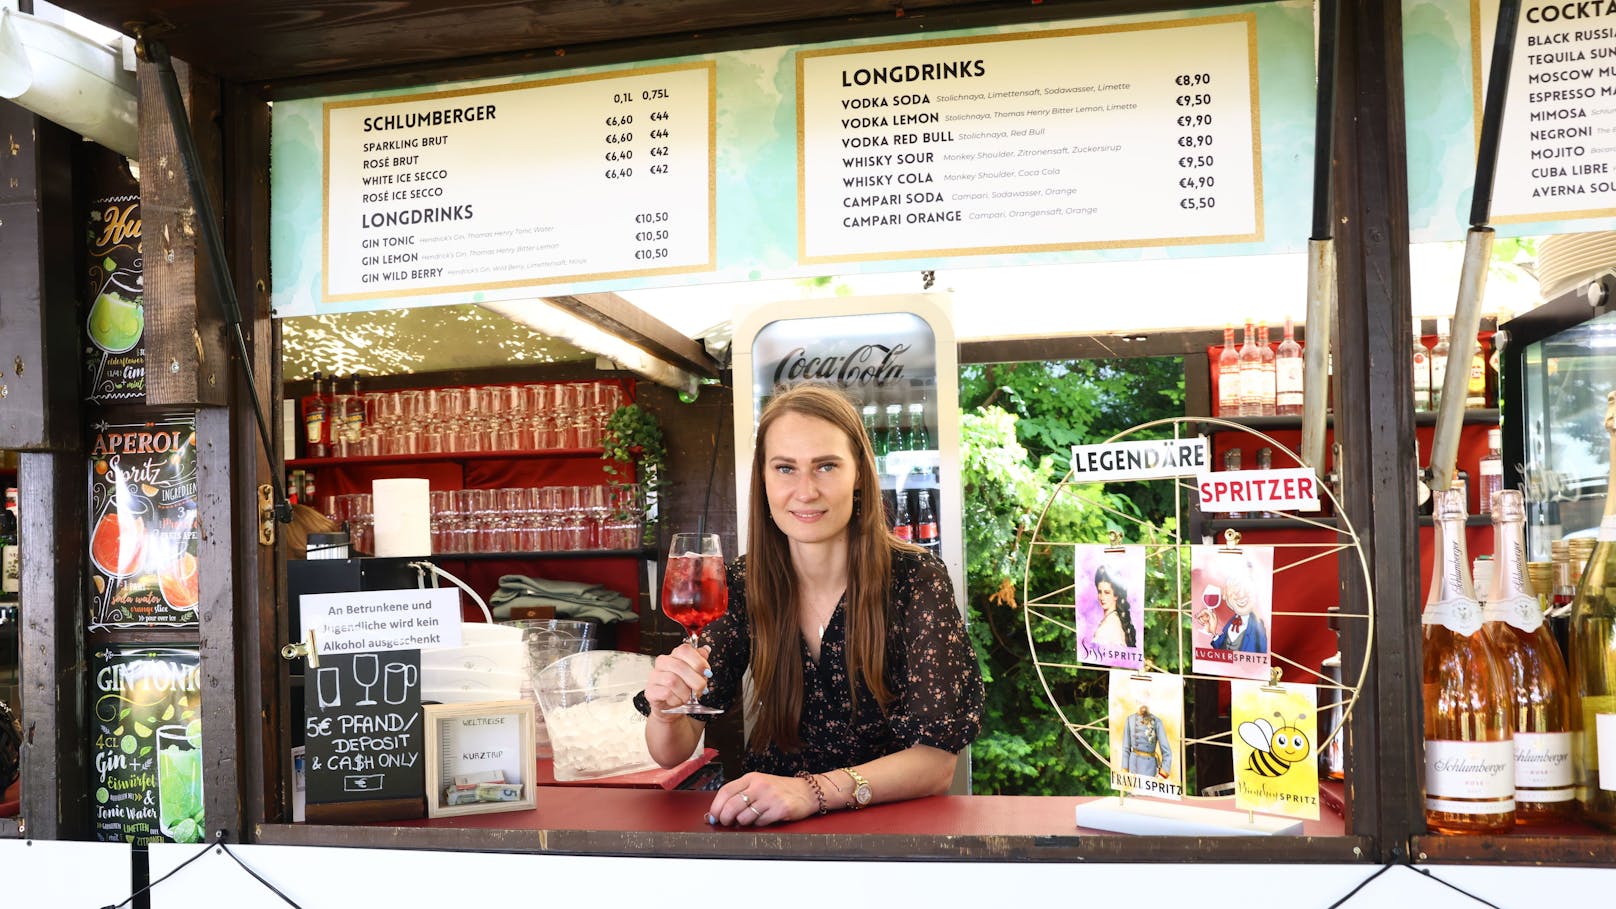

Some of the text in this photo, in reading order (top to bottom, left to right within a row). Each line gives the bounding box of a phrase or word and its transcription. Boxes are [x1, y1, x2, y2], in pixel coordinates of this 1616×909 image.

[1528, 28, 1616, 47] BLACK RUSSI
[1528, 51, 1585, 66] TEQUILA
[842, 60, 985, 87] LONGDRINKS
[1528, 68, 1594, 84] MOSCOW
[614, 88, 669, 104] 0,1L 0,75L
[842, 73, 1210, 110] VODKA SODA Stolichnaya, Limettensaft, Sodawasser, Limette €8,90
[1529, 87, 1596, 103] ESPRESSO
[363, 104, 497, 132] SCHLUMBERGER
[842, 93, 1211, 129] VODKA LEMON Stolichnaya, Thomas Henry Bitter Lemon, Limette €9,50
[1530, 108, 1586, 122] MIMOSA
[363, 111, 669, 152] SPARKLING BRUT €6,60 €44
[842, 114, 1212, 148] VODKA RED BULL Stolichnaya, Red Bull €9,90
[1530, 126, 1592, 141] NEGRONI
[363, 129, 669, 169] ROSÉ BRUT €6,60 €44
[842, 135, 1213, 168] WHISKY SOUR Monkey Shoulder, Zitronensaft, Zuckersirup €8,90
[1531, 146, 1585, 160] MOJITO
[362, 146, 669, 186] WHITE ICE SECCO €6,40 €42
[843, 155, 1214, 188] WHISKY COLA Monkey Shoulder, Coca Cola €9,50
[1531, 163, 1609, 179] CUBA LIBRE
[362, 164, 669, 203] ROSÉ ICE SECCO €6,40 €42
[843, 194, 901, 208] CAMPARI
[906, 192, 944, 204] SODA
[991, 189, 1043, 199] Sodawasser,
[1044, 186, 1078, 196] Orange
[1179, 176, 1215, 190] €4,90
[1532, 184, 1586, 198] AVERNA
[362, 204, 473, 229] LONGDRINKS
[843, 214, 901, 228] CAMPARI
[906, 210, 962, 224] ORANGE
[1009, 206, 1064, 218] Orangensaft,
[1065, 205, 1098, 215] Orange
[1180, 197, 1215, 210] €5,50
[362, 212, 669, 249] GIN TONIC €10,50
[362, 230, 669, 266] GIN LEMON €10,50
[362, 274, 379, 284] GIN
[382, 270, 408, 282] WILD
[411, 267, 444, 280] BERRY
[635, 248, 668, 260] €10,50
[773, 343, 912, 388] Coca-Cola
[92, 431, 183, 455] APEROL
[1075, 441, 1205, 473] LEGENDÄRE
[105, 455, 171, 486] Spritz
[1201, 477, 1313, 503] SPRITZER
[328, 600, 432, 616] An Betrunkene und
[390, 619, 414, 629] wird
[416, 617, 439, 627] kein
[323, 639, 365, 652] Alkohol
[1108, 650, 1143, 662] SPRITZ
[306, 712, 419, 738] 5€ PFAND/
[463, 717, 505, 727] WELTREISE
[331, 734, 410, 753] DEPOSIT
[327, 753, 375, 772] CA$H
[378, 752, 419, 768] ONLY
[463, 750, 503, 760] KURZTRIP
[96, 750, 127, 783] Gin
[1434, 760, 1505, 777] Schlumberger
[108, 772, 156, 791] Eiswürfel
[1145, 780, 1182, 796] SPRITZ
[143, 790, 155, 805] &
[1280, 793, 1317, 805] SPRITZ
[96, 804, 157, 820] Tonic Water
